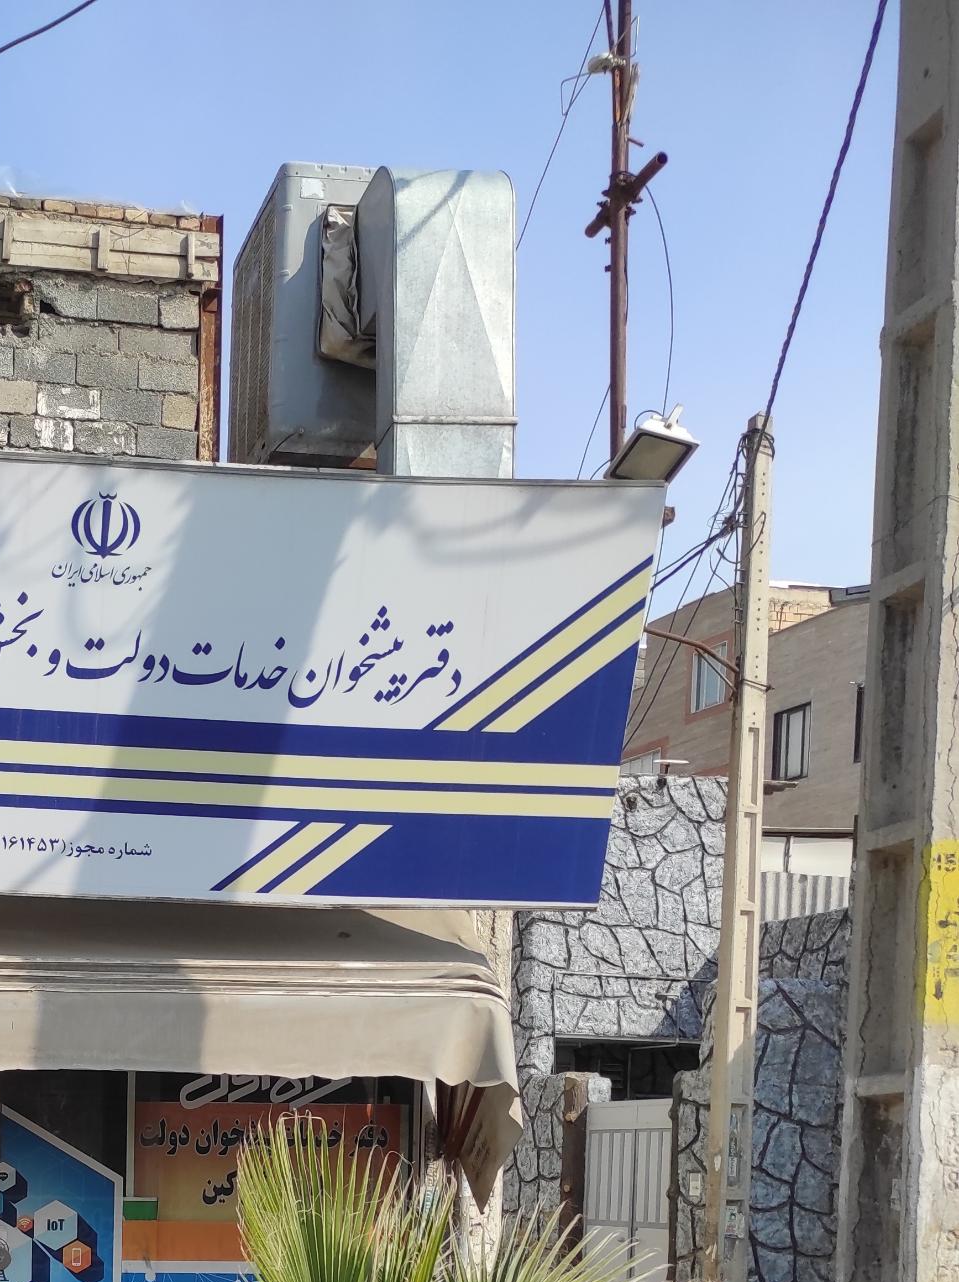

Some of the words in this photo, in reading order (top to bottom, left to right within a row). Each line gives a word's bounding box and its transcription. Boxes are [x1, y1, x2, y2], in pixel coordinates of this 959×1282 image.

[51, 561, 82, 588] ایران
[80, 562, 115, 584] اسلامی
[112, 565, 153, 592] جمهوری
[43, 648, 62, 677] و
[66, 629, 171, 685] دولت
[171, 636, 289, 691] خدمات
[288, 604, 405, 709] پیشخوان
[389, 620, 462, 706] دفتر
[108, 842, 153, 859] شماره
[140, 1117, 191, 1156] دولت
